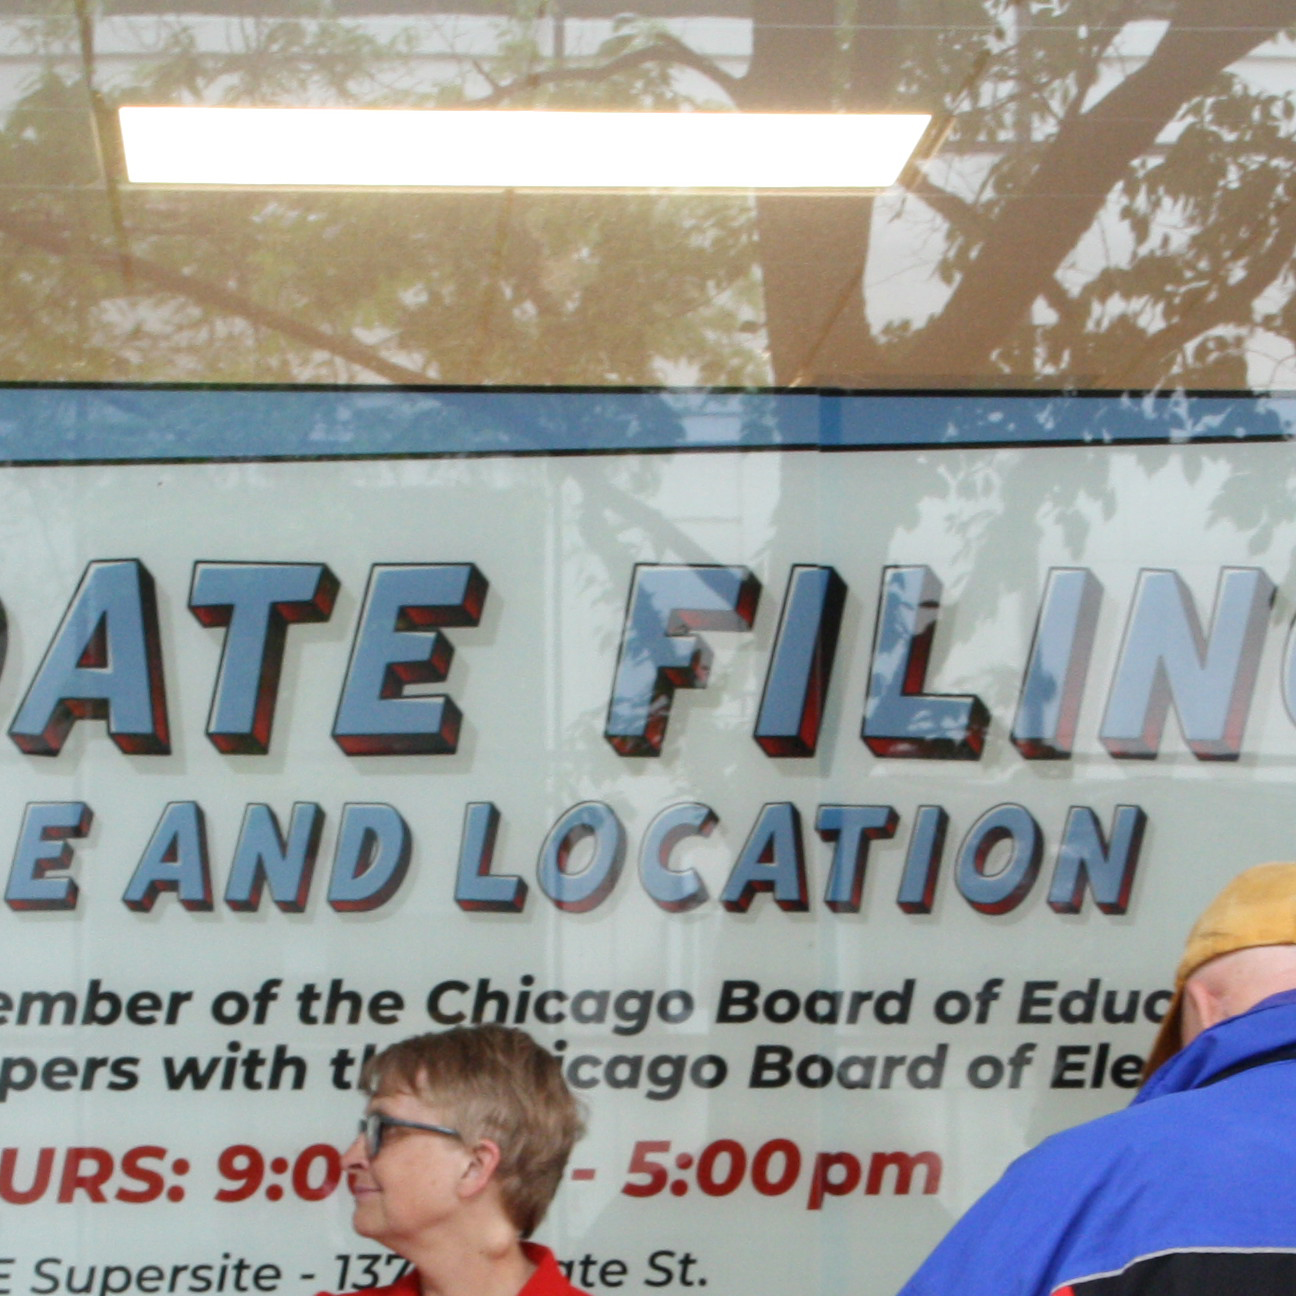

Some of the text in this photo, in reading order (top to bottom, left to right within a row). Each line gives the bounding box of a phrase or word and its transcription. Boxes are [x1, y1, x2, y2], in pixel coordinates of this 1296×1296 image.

[122, 801, 414, 913] AND
[454, 801, 1148, 915] LOCATION
[210, 977, 284, 1026] of
[299, 978, 405, 1026] the
[426, 974, 695, 1036] Chicago
[714, 977, 917, 1026] Board
[932, 977, 1005, 1026] of
[162, 1040, 308, 1092] with
[747, 1042, 950, 1091] Board
[966, 1042, 1038, 1090] of
[214, 1143, 344, 1204] 9:0
[621, 1137, 944, 1212] 5:00pm
[643, 1249, 708, 1288] St.
